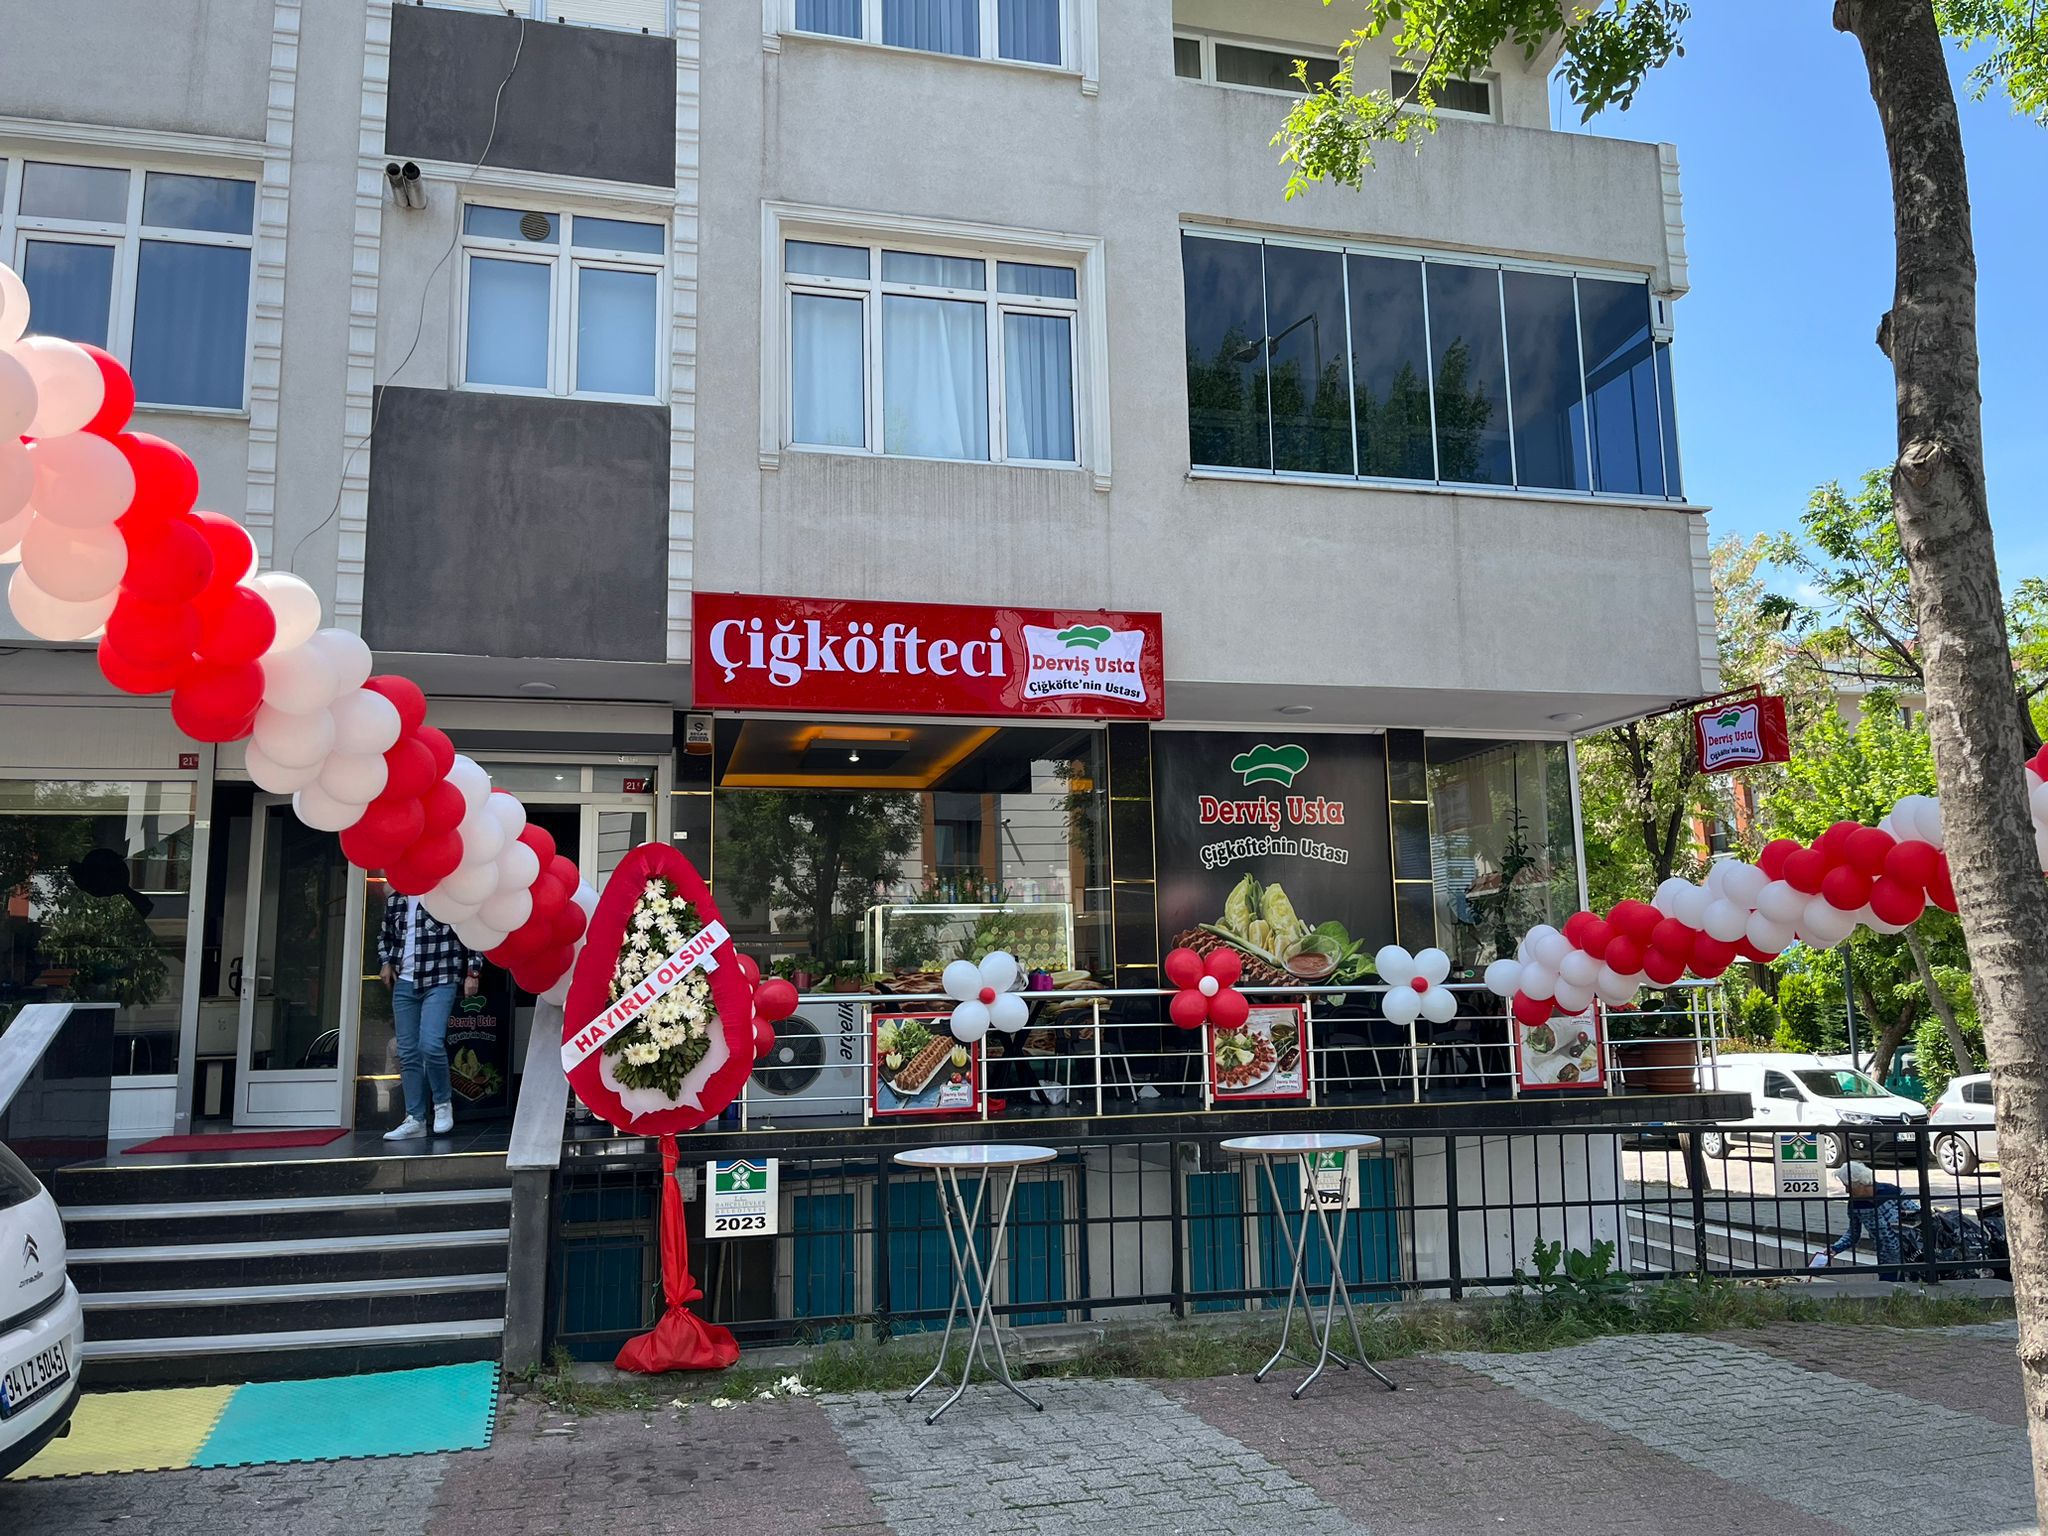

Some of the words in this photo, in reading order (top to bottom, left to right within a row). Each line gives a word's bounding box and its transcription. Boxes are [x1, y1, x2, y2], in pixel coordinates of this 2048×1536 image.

[709, 618, 1006, 687] Çiğköfteci
[1032, 654, 1090, 676] Derviş
[1095, 656, 1136, 674] Usta
[1105, 682, 1141, 699] Ustası
[1708, 733, 1733, 746] Derviş
[1734, 730, 1753, 742] Usta
[1199, 796, 1281, 831] Derviş
[1286, 796, 1344, 824] Usta
[1300, 838, 1349, 865] Ustası
[575, 983, 656, 1053] HAYIRLI
[657, 931, 716, 985] OLSUN
[1783, 1182, 1819, 1192] 2023
[715, 1216, 766, 1231] 2023
[5, 1370, 22, 1401] 34
[20, 1360, 38, 1392] LZ
[36, 1346, 63, 1382] 5045
